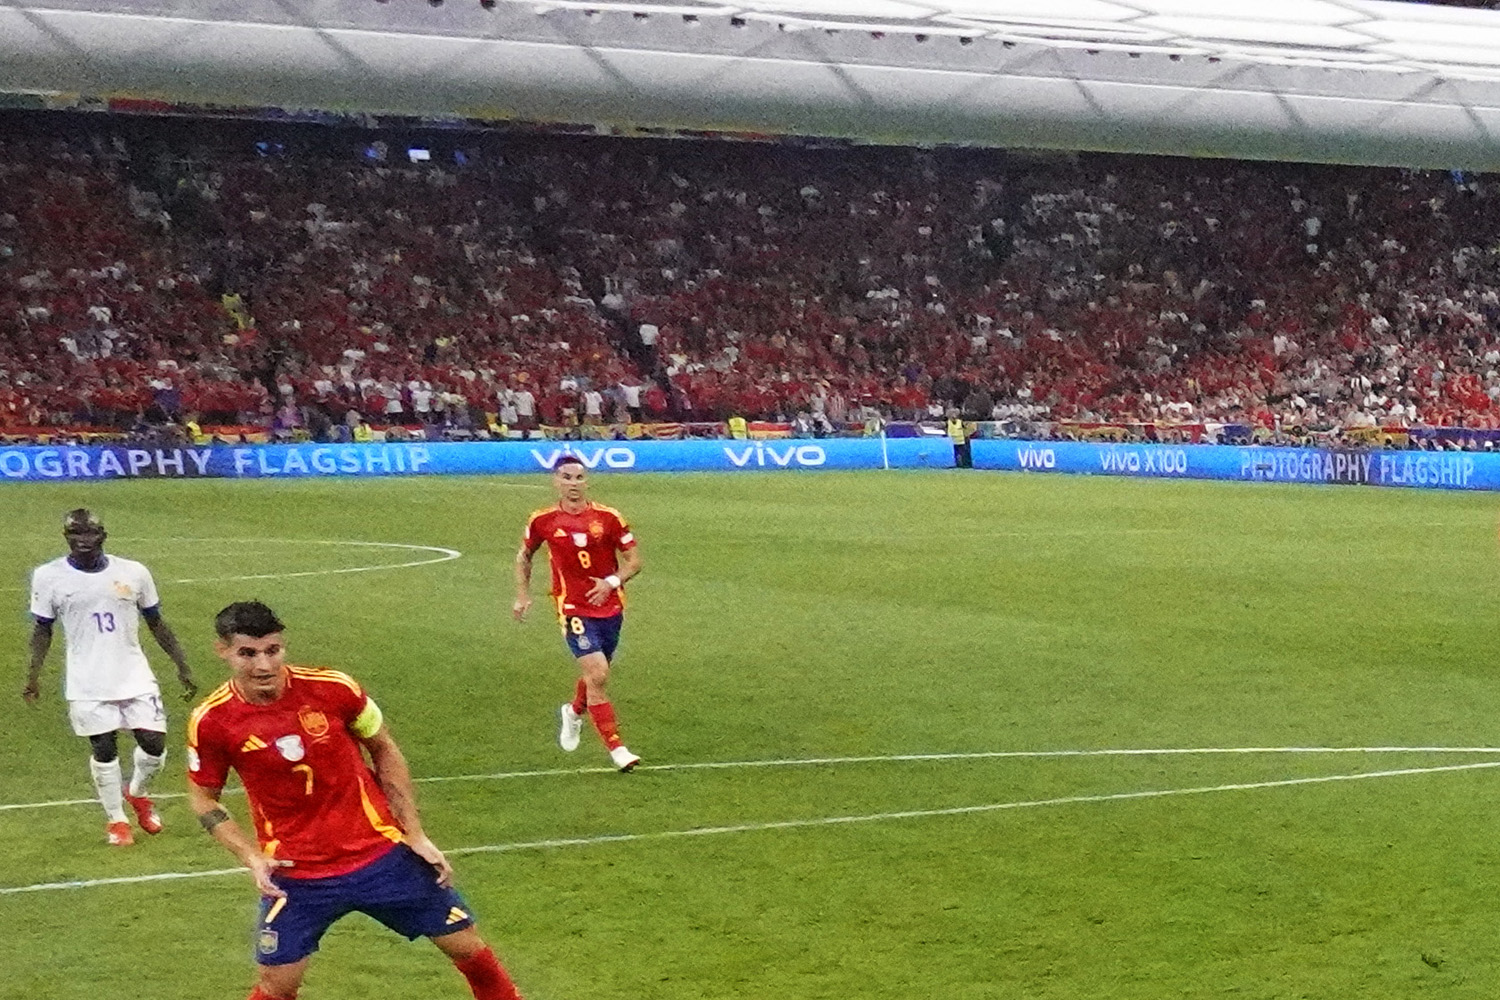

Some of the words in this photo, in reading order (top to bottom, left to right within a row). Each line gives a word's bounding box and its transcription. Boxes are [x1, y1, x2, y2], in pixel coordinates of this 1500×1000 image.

[233, 447, 430, 474] FLAGSHIP
[723, 442, 827, 467] vivo
[1017, 444, 1056, 468] vivo
[1100, 446, 1140, 471] vivo
[1144, 449, 1187, 473] X100
[1241, 451, 1372, 482] PHOTOGRAPHY
[1380, 455, 1474, 485] FLAGSHIP
[577, 550, 591, 569] 8
[93, 611, 116, 633] 13
[570, 616, 585, 634] 8
[291, 764, 314, 795] 7
